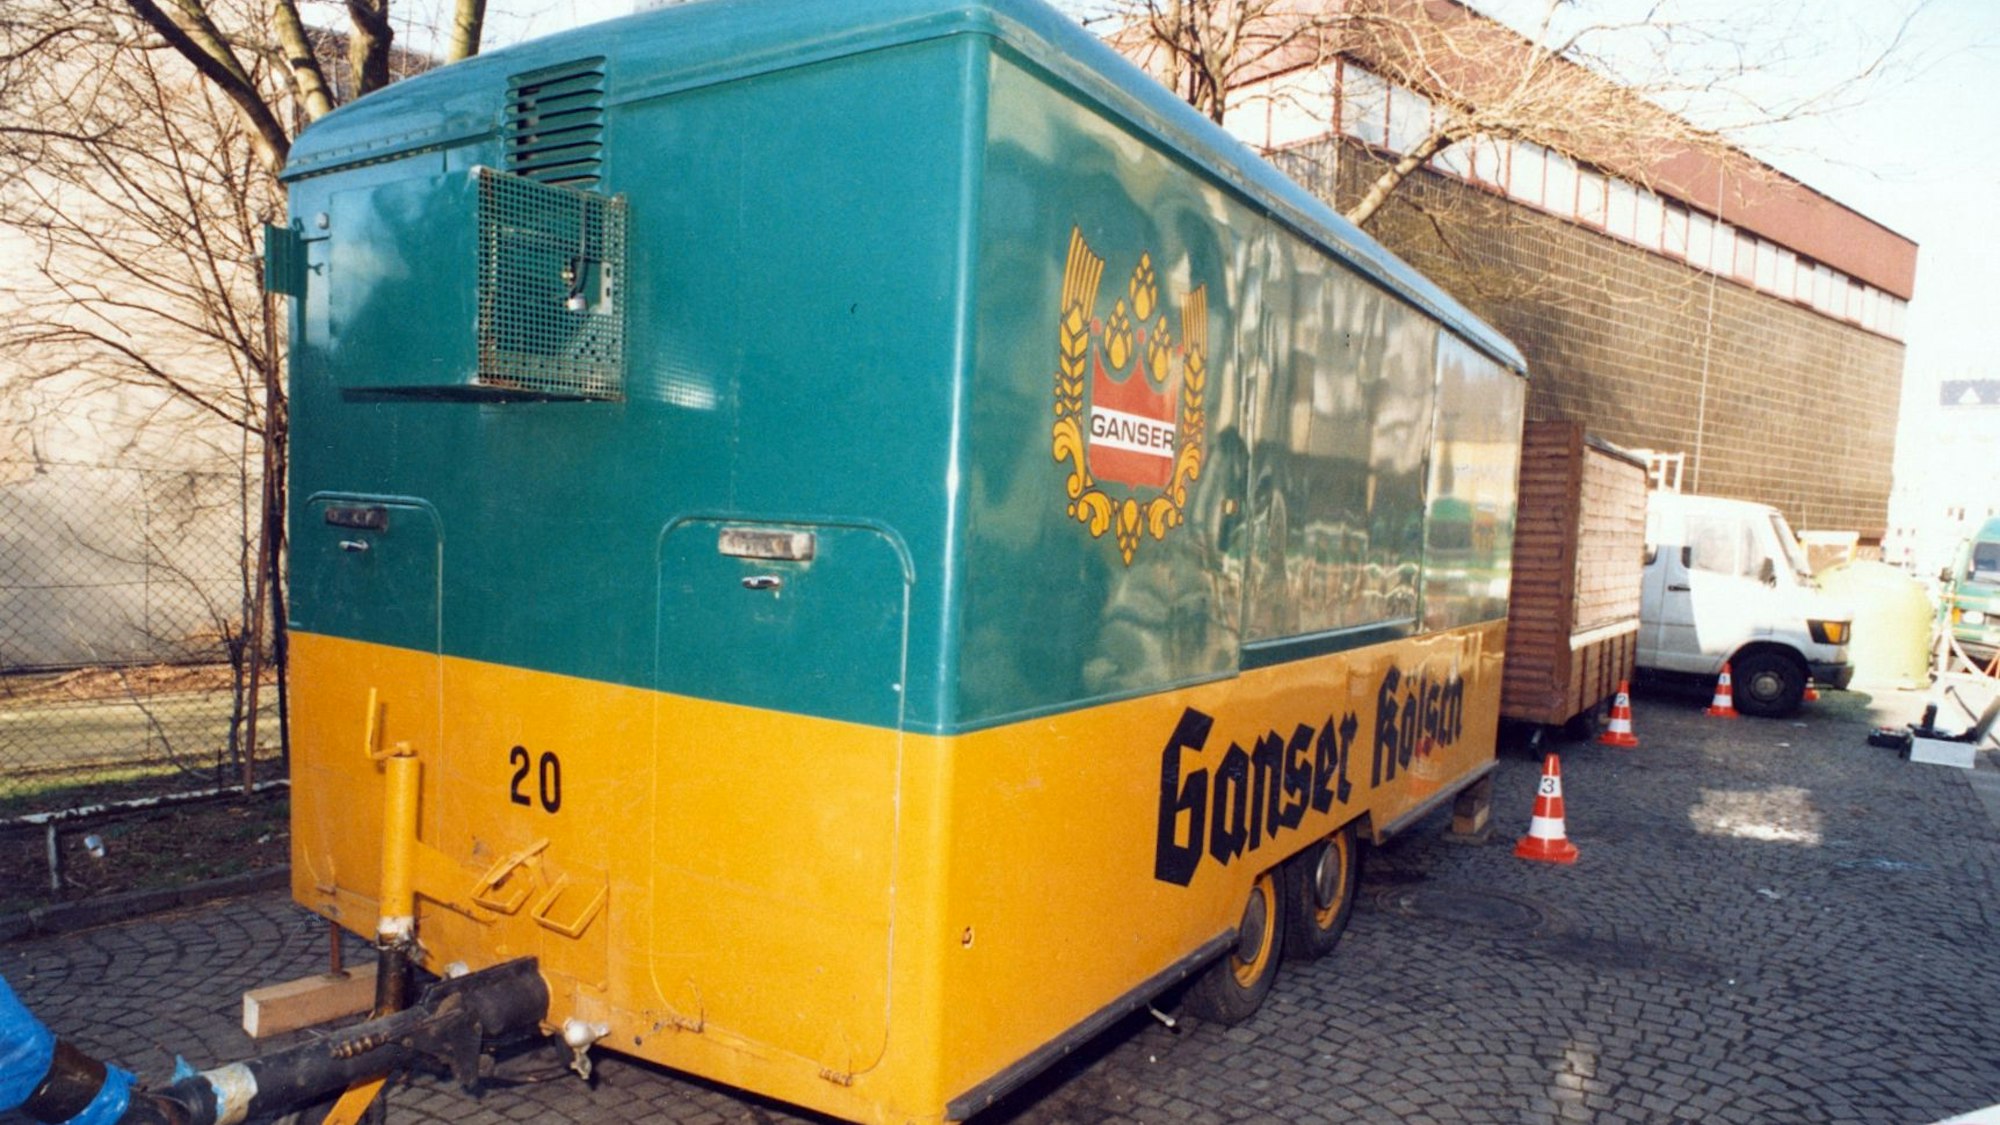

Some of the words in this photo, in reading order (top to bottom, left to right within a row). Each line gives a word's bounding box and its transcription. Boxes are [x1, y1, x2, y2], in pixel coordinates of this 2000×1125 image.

[1090, 413, 1176, 451] GANSER
[1617, 694, 1626, 705] 2
[509, 745, 562, 814] 20
[1154, 706, 1359, 887] Ganser
[1541, 777, 1555, 795] 3
